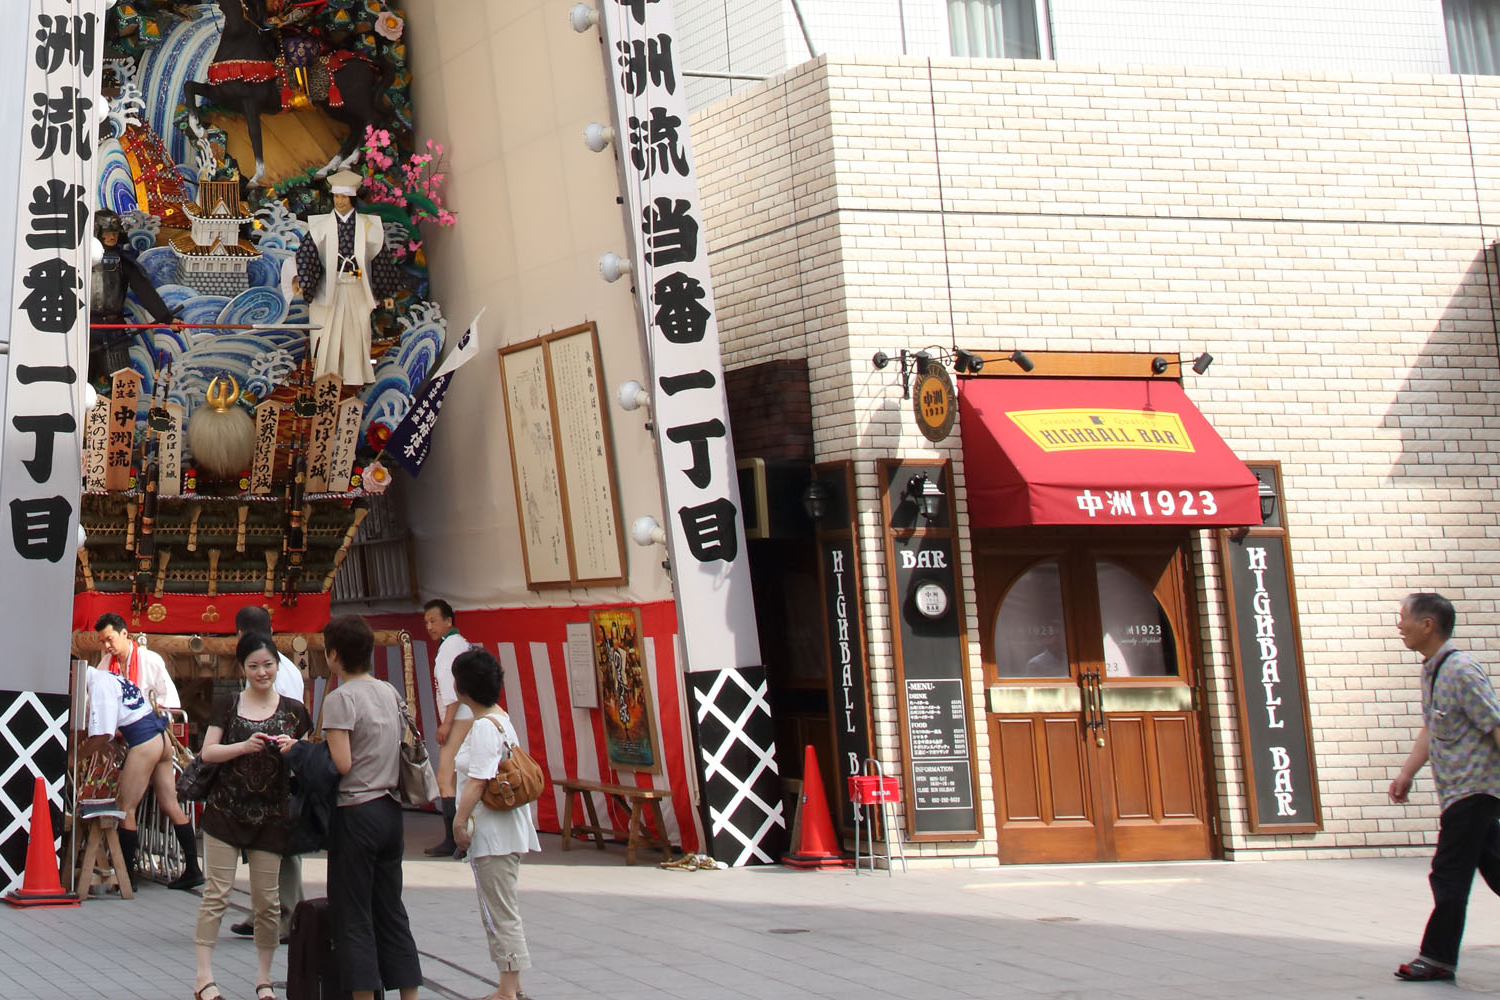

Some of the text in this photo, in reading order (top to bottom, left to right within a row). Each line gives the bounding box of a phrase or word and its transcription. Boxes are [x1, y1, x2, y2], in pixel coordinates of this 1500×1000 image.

[924, 389, 944, 407] 中洲
[925, 406, 944, 417] 1923
[108, 405, 136, 468] 中洲流
[1039, 427, 1180, 445] HIGHBALL BAR
[1076, 489, 1218, 517] 中洲1923
[900, 550, 948, 569] BAR
[832, 550, 856, 733] HIGHBALL
[1246, 547, 1297, 817] HIGHBALL BAR
